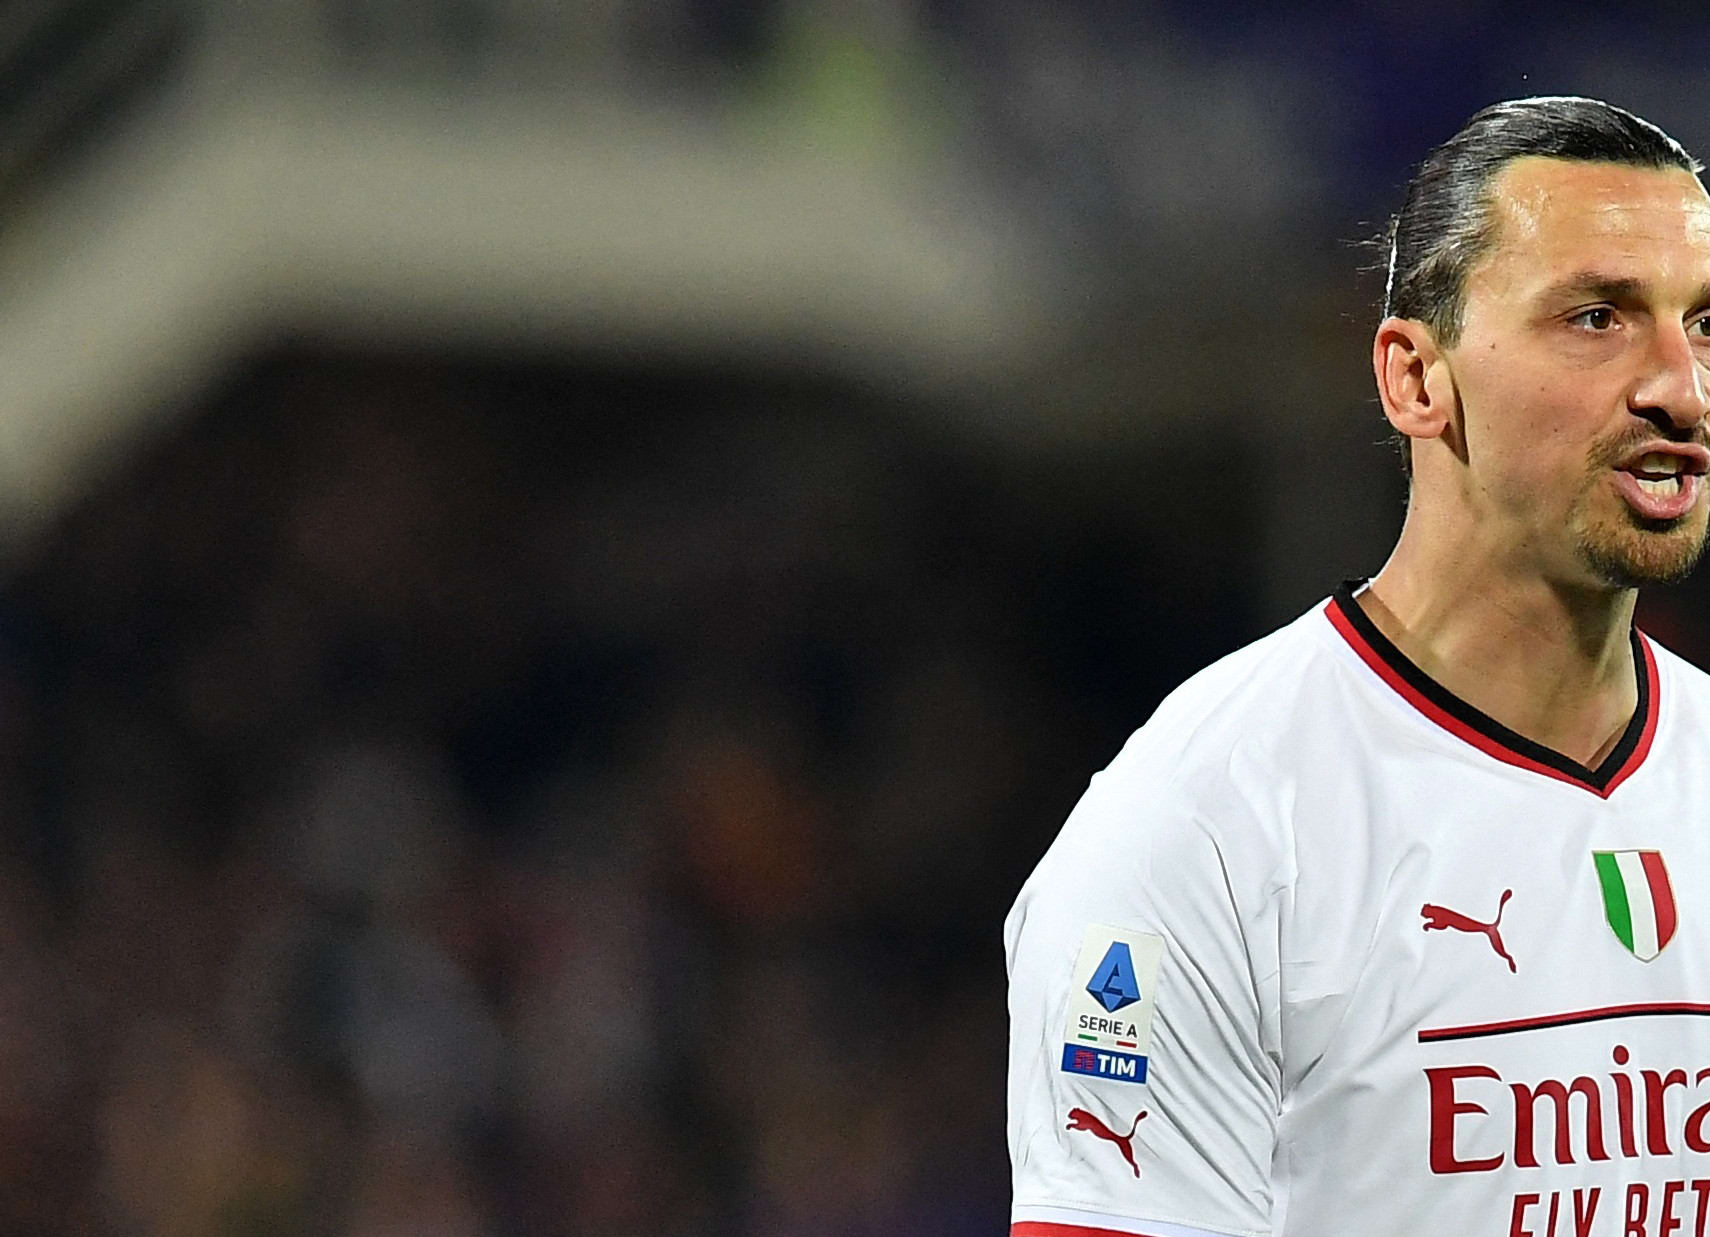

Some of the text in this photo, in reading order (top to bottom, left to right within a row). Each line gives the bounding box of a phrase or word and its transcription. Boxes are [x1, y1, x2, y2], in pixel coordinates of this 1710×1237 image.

[1078, 1014, 1138, 1039] SERIE A
[1097, 1053, 1137, 1078] TIM
